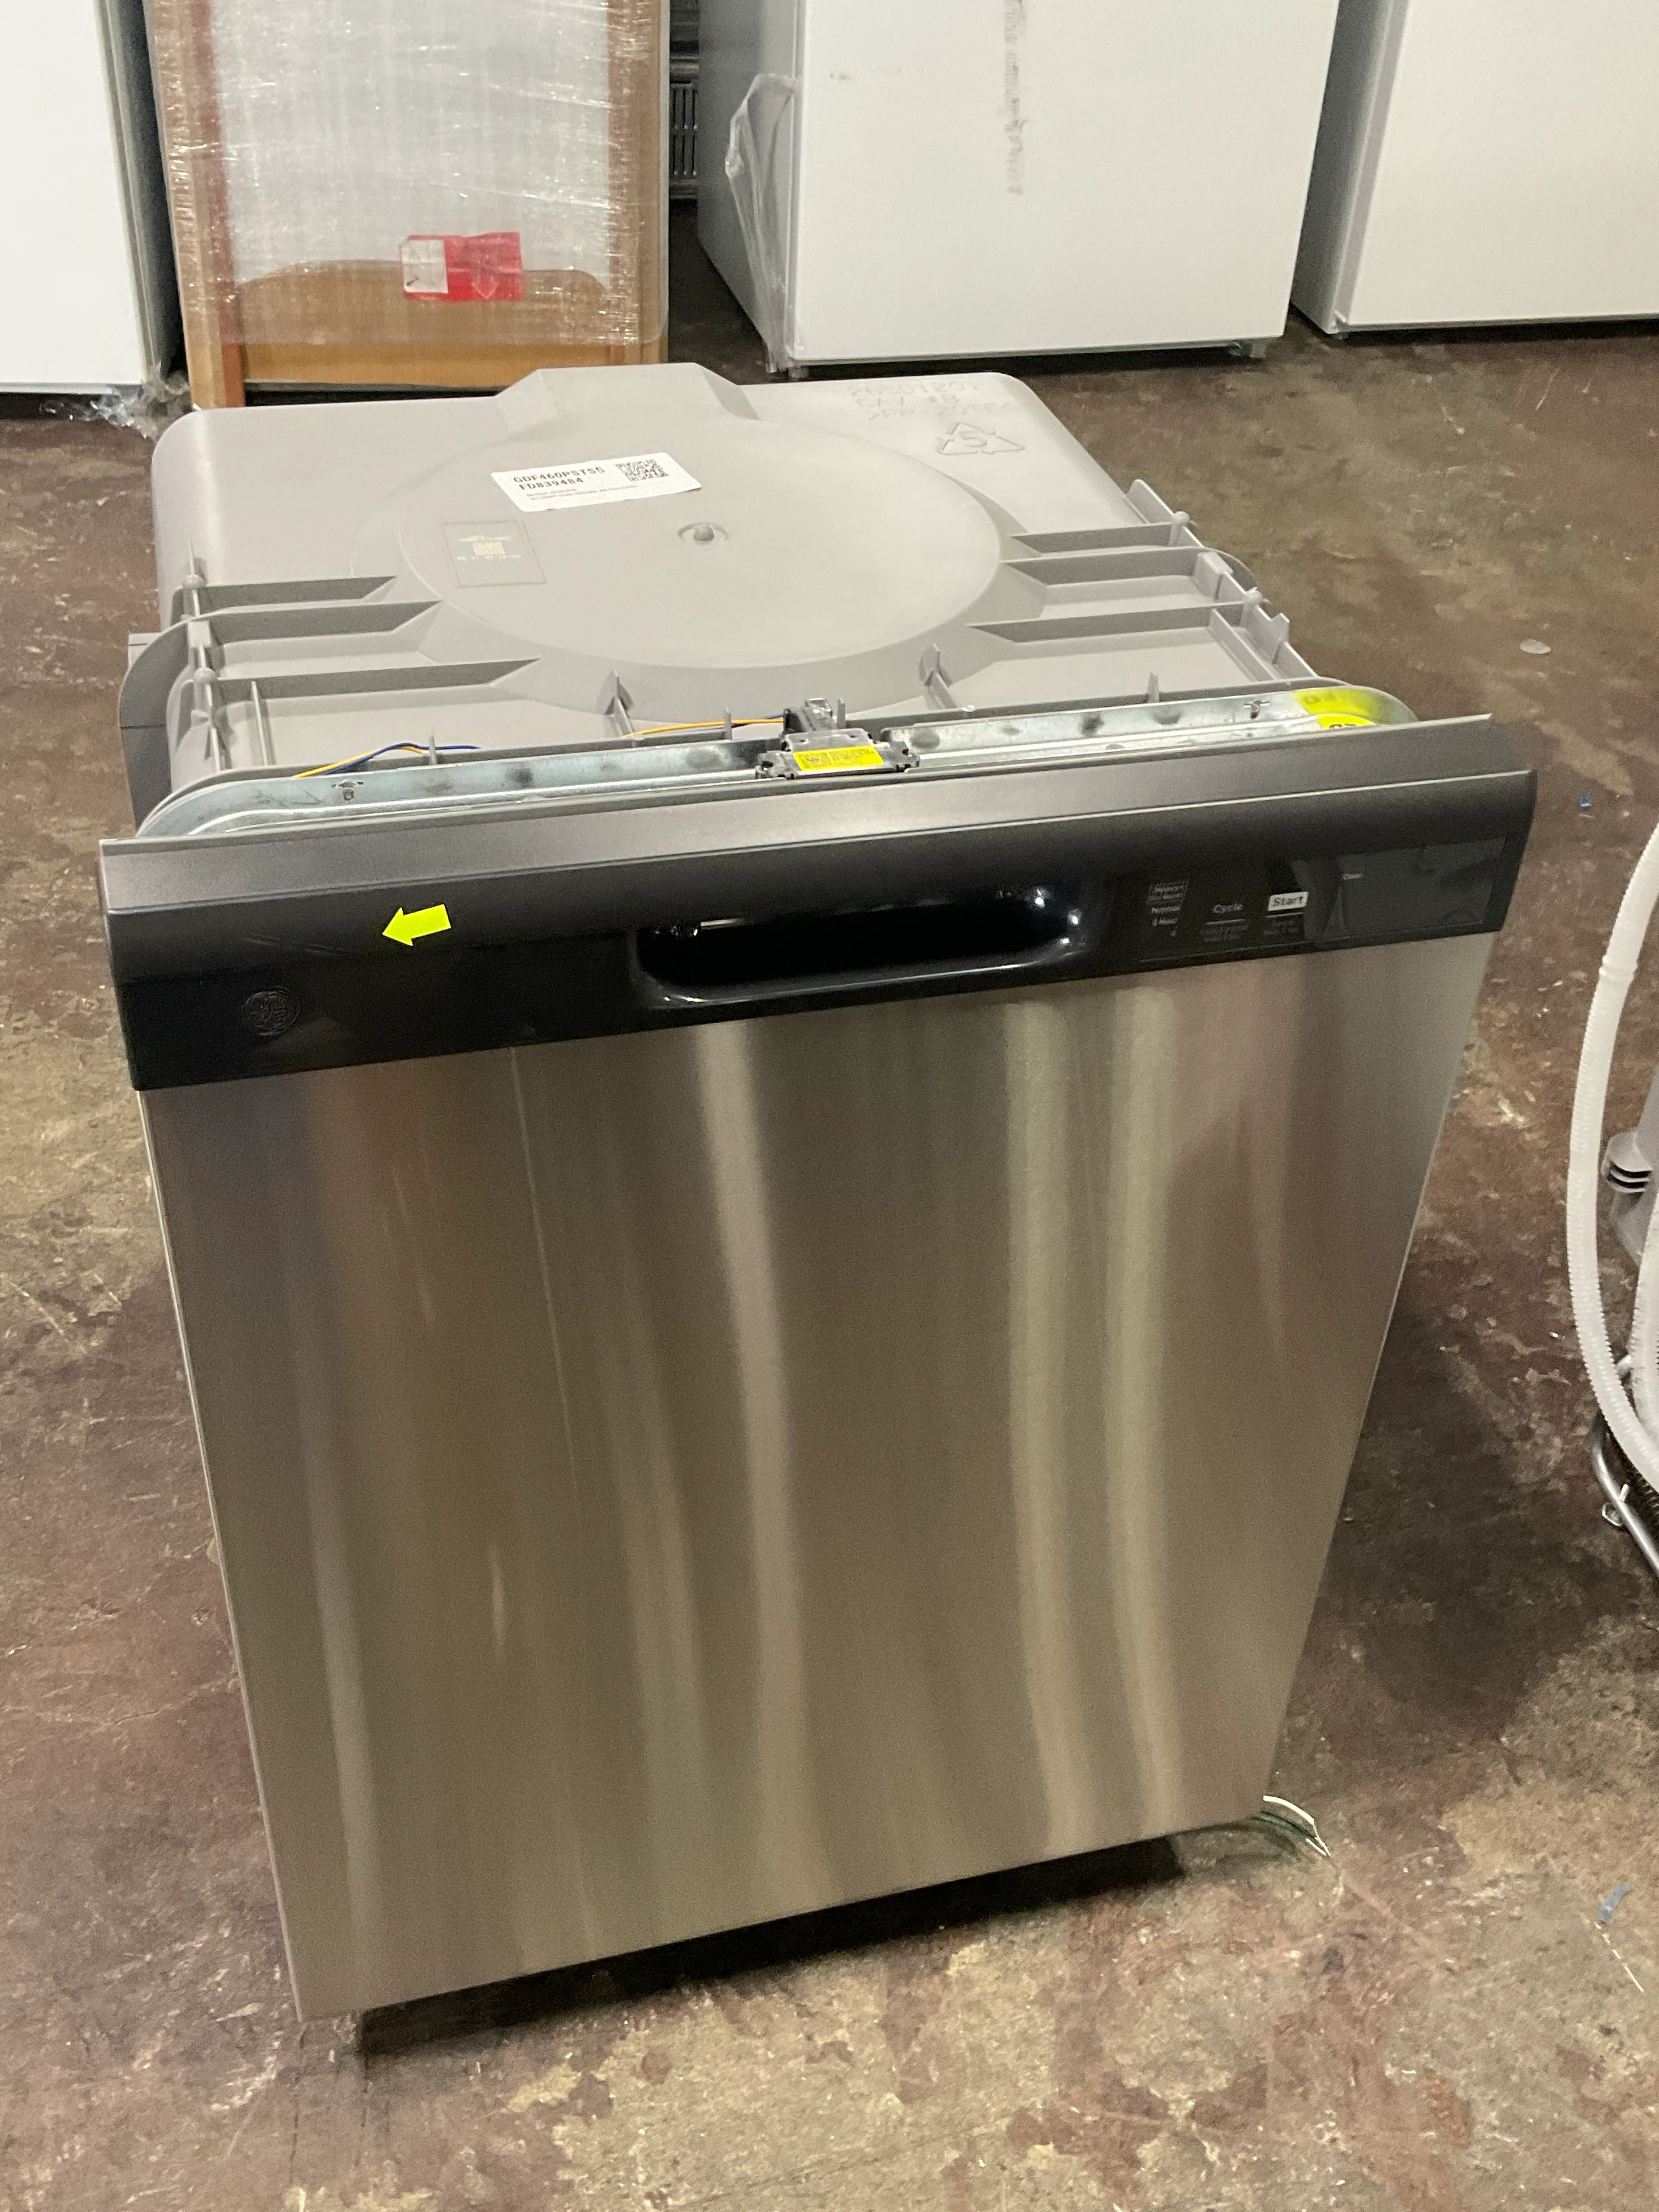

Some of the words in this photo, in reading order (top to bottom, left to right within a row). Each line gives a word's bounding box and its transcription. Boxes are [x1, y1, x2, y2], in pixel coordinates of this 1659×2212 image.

[514, 466, 605, 483] GDF460PSTSS
[518, 477, 584, 490] FD839484
[1272, 895, 1305, 907] Start
